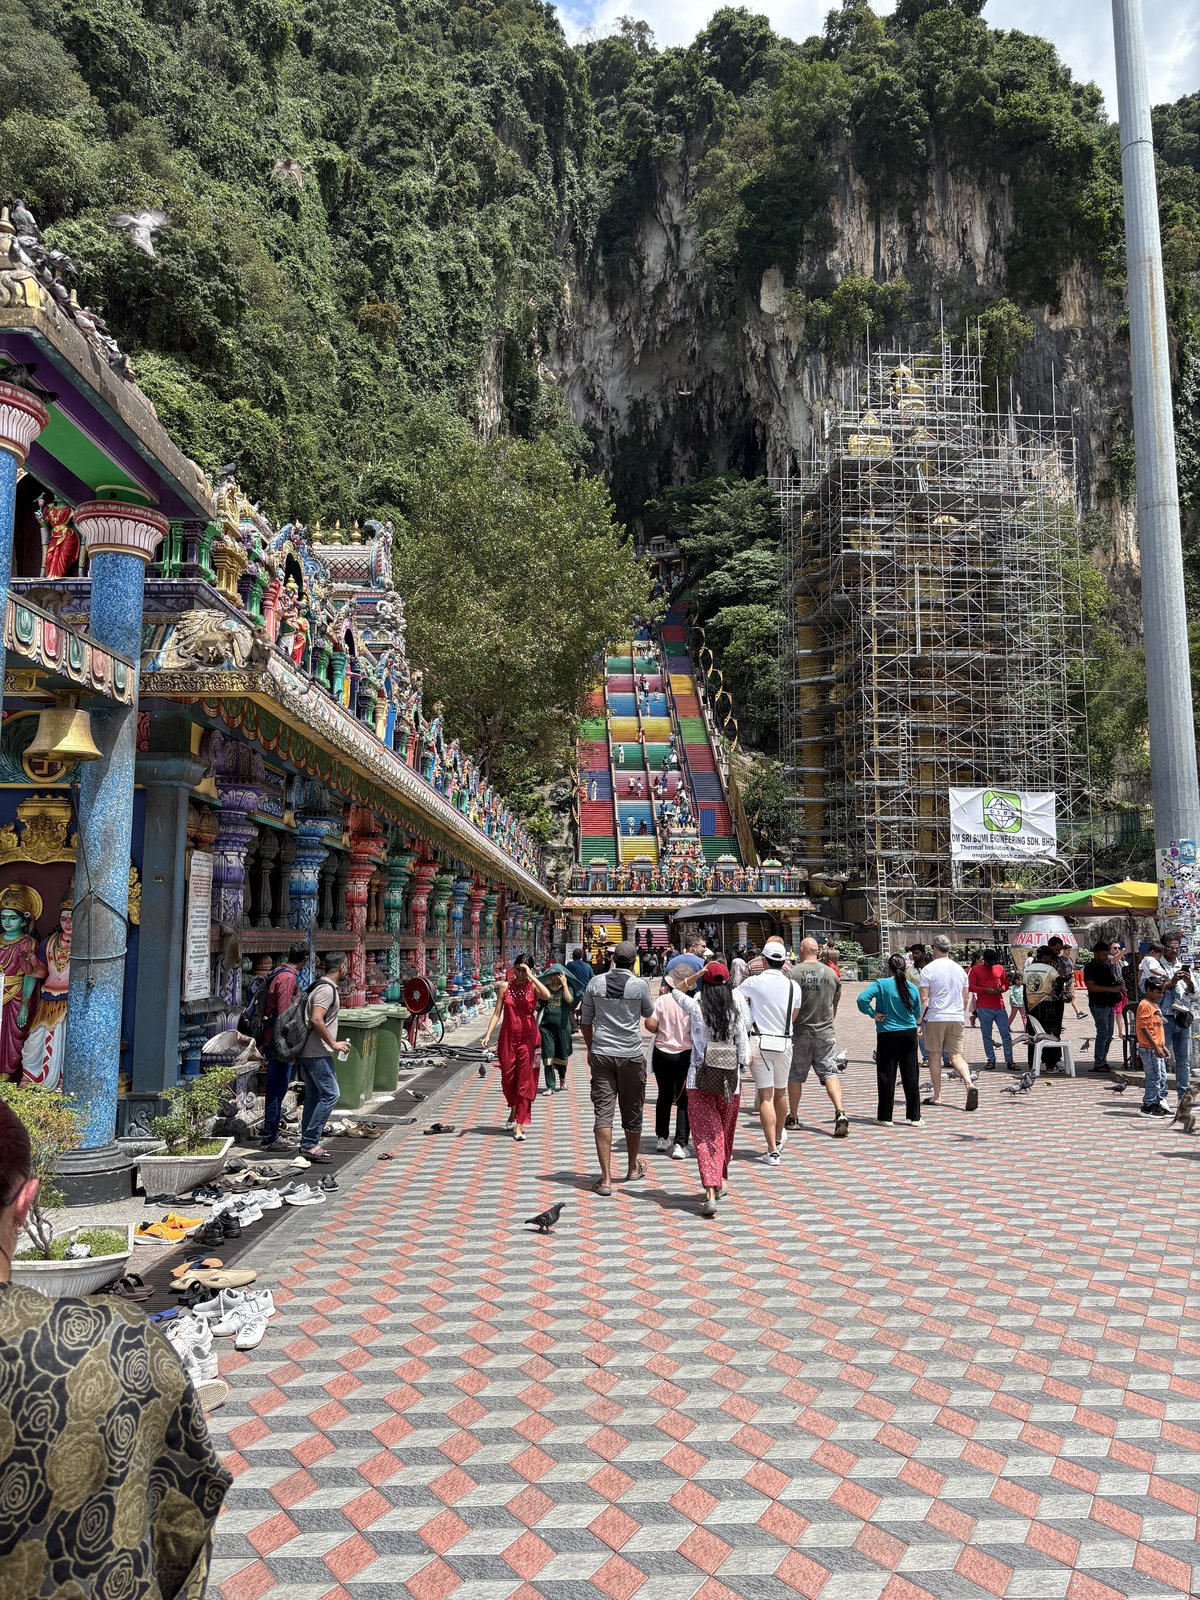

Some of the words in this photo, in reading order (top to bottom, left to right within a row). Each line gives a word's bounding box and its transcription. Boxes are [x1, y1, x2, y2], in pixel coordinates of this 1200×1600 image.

[952, 833, 960, 842] OM
[962, 833, 971, 842] SRI
[973, 833, 989, 843] BUMI
[990, 833, 1025, 845] ENGINEERING
[1026, 837, 1041, 846] SDN.
[1042, 837, 1056, 847] BHD.
